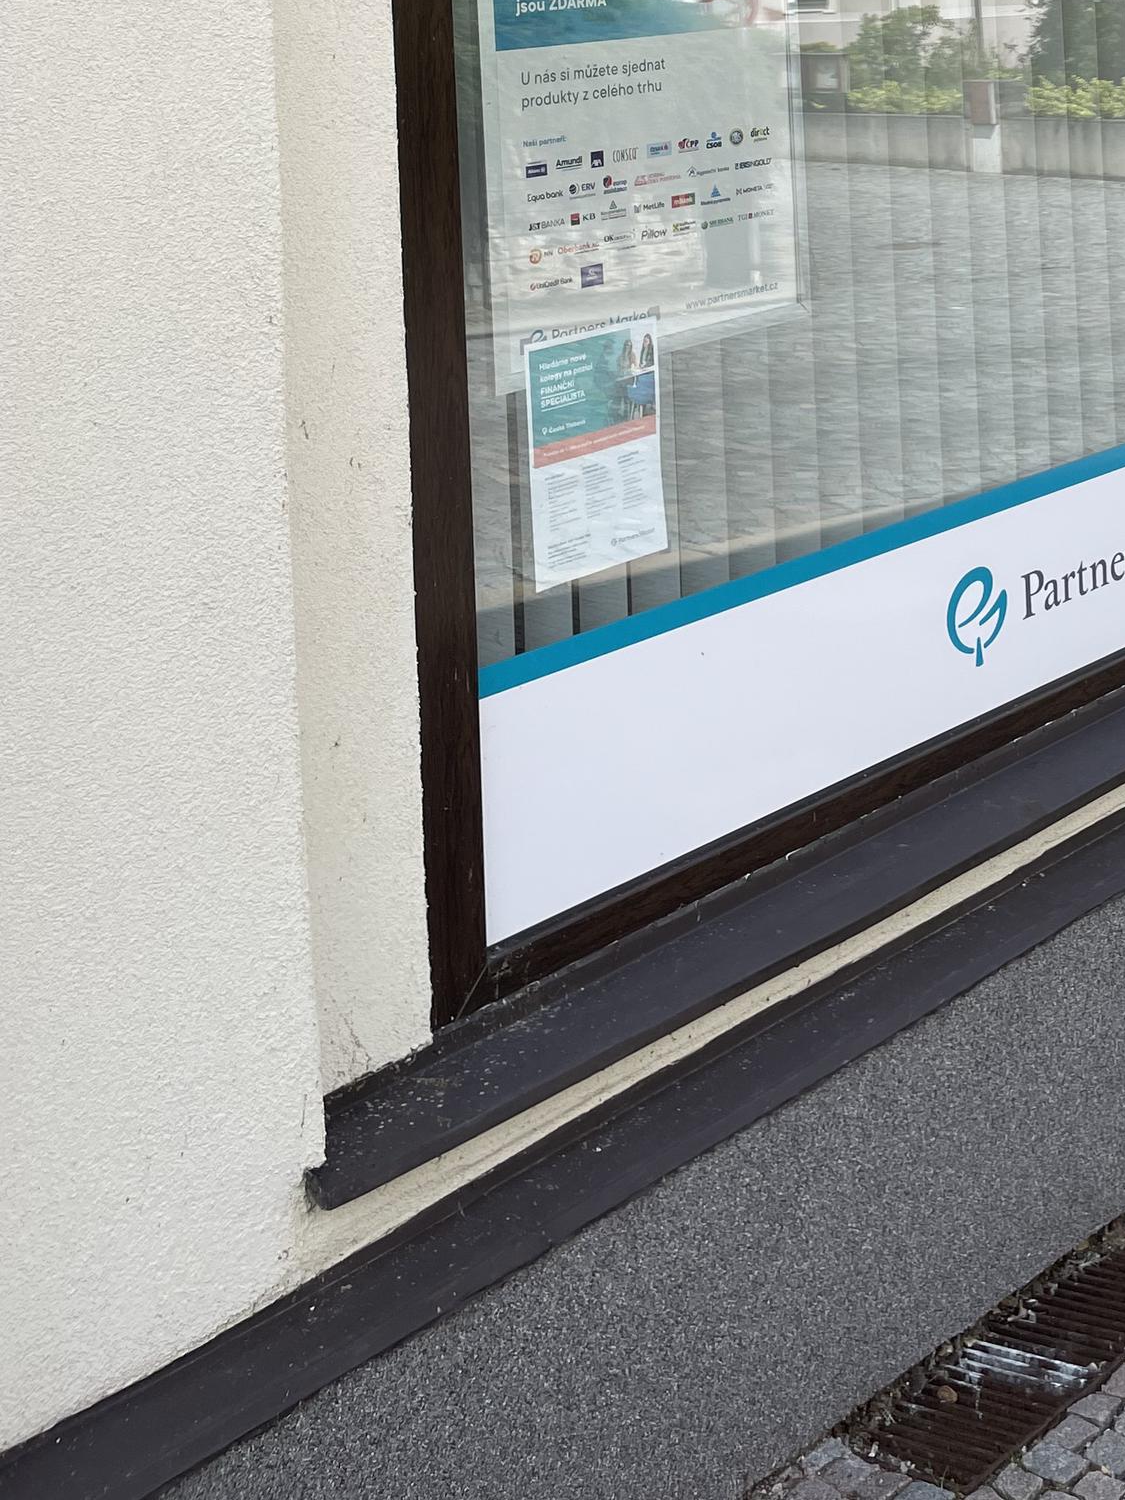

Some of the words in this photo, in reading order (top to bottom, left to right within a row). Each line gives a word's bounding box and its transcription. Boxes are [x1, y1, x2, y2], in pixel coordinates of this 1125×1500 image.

[521, 72, 531, 86] U
[534, 70, 557, 85] nás
[560, 68, 570, 81] si
[574, 63, 618, 80] můžete
[622, 58, 666, 78] sjednat
[521, 90, 579, 111] produkty
[583, 92, 589, 102] z
[592, 84, 635, 100] celého
[638, 80, 662, 94] trhu
